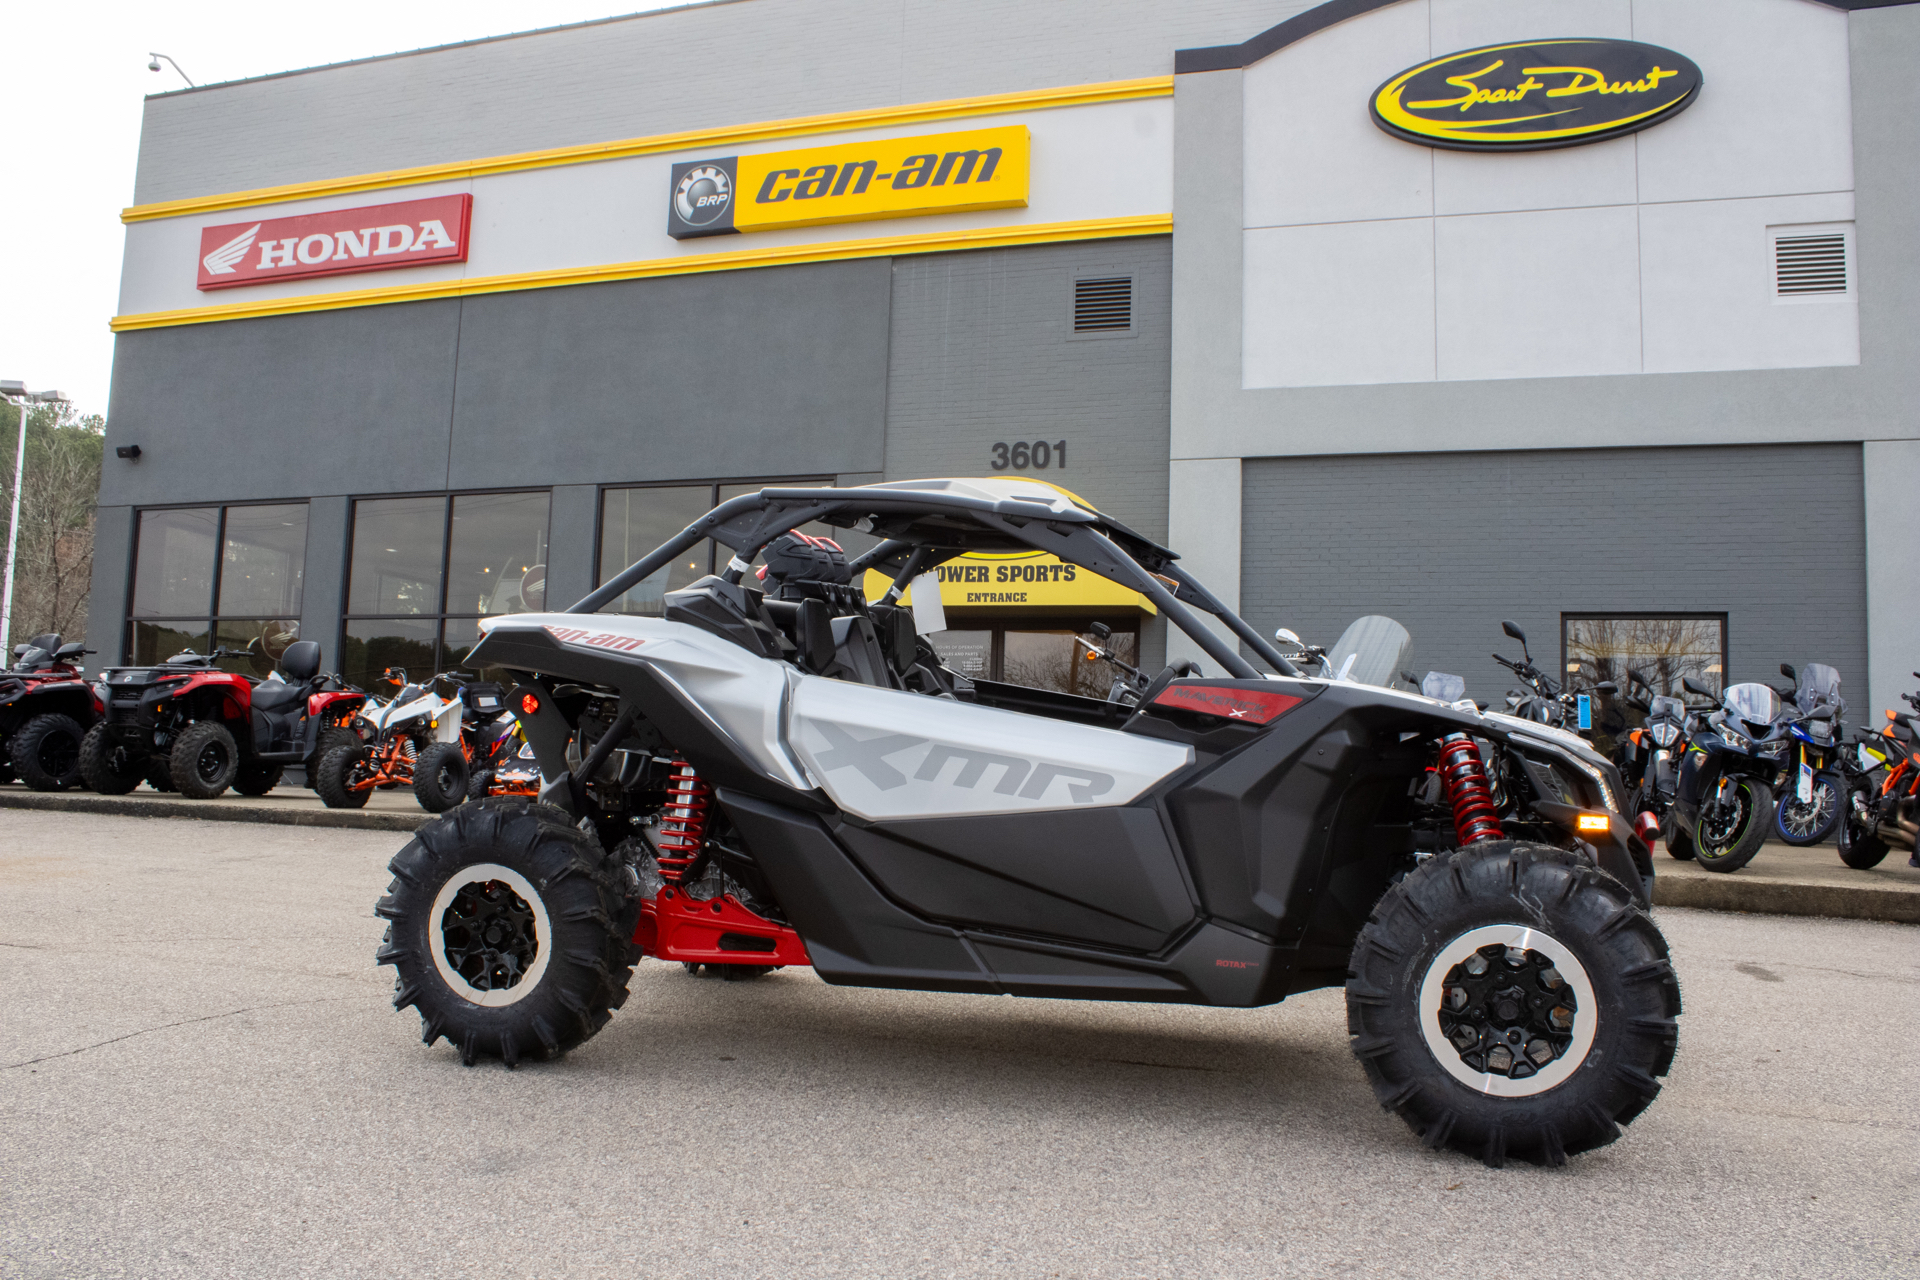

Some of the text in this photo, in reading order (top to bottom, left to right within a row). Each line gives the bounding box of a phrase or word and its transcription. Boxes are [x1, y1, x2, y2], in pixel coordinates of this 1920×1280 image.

[696, 193, 729, 208] BRP
[256, 219, 456, 270] HONDA
[991, 440, 1066, 471] 3601
[930, 565, 1076, 583] OWER SPORTS
[967, 592, 1027, 603] ENTRANCE
[1173, 688, 1268, 714] MAVERICK
[1216, 959, 1246, 969] ROTAX
